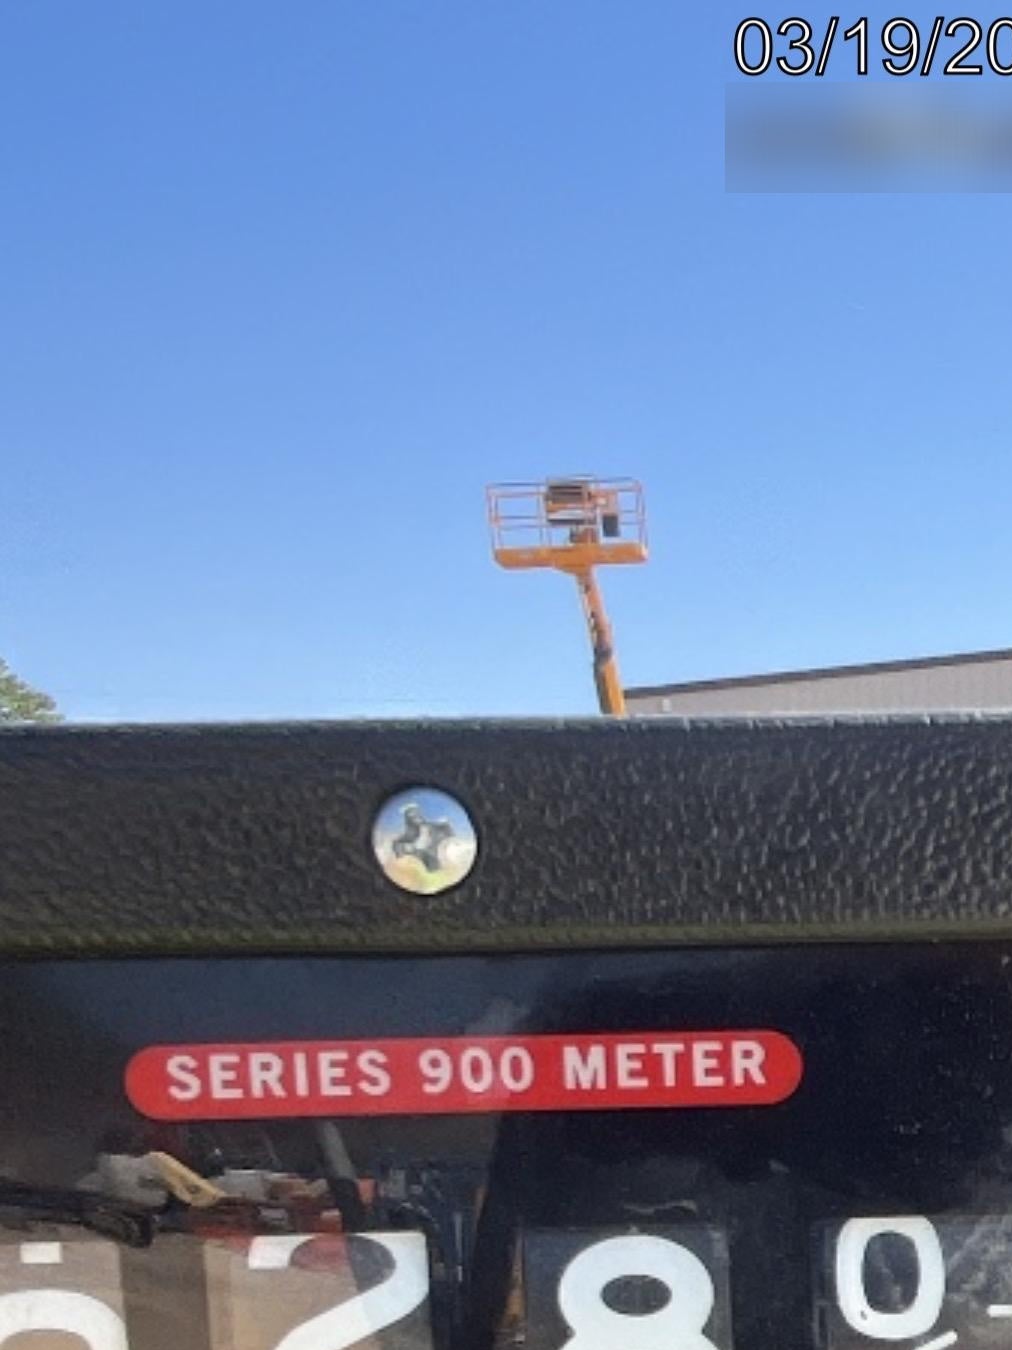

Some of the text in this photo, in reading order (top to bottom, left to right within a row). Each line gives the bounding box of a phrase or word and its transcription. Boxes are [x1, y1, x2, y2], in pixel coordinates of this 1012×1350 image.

[165, 1040, 768, 1101] SERIES 900 METER
